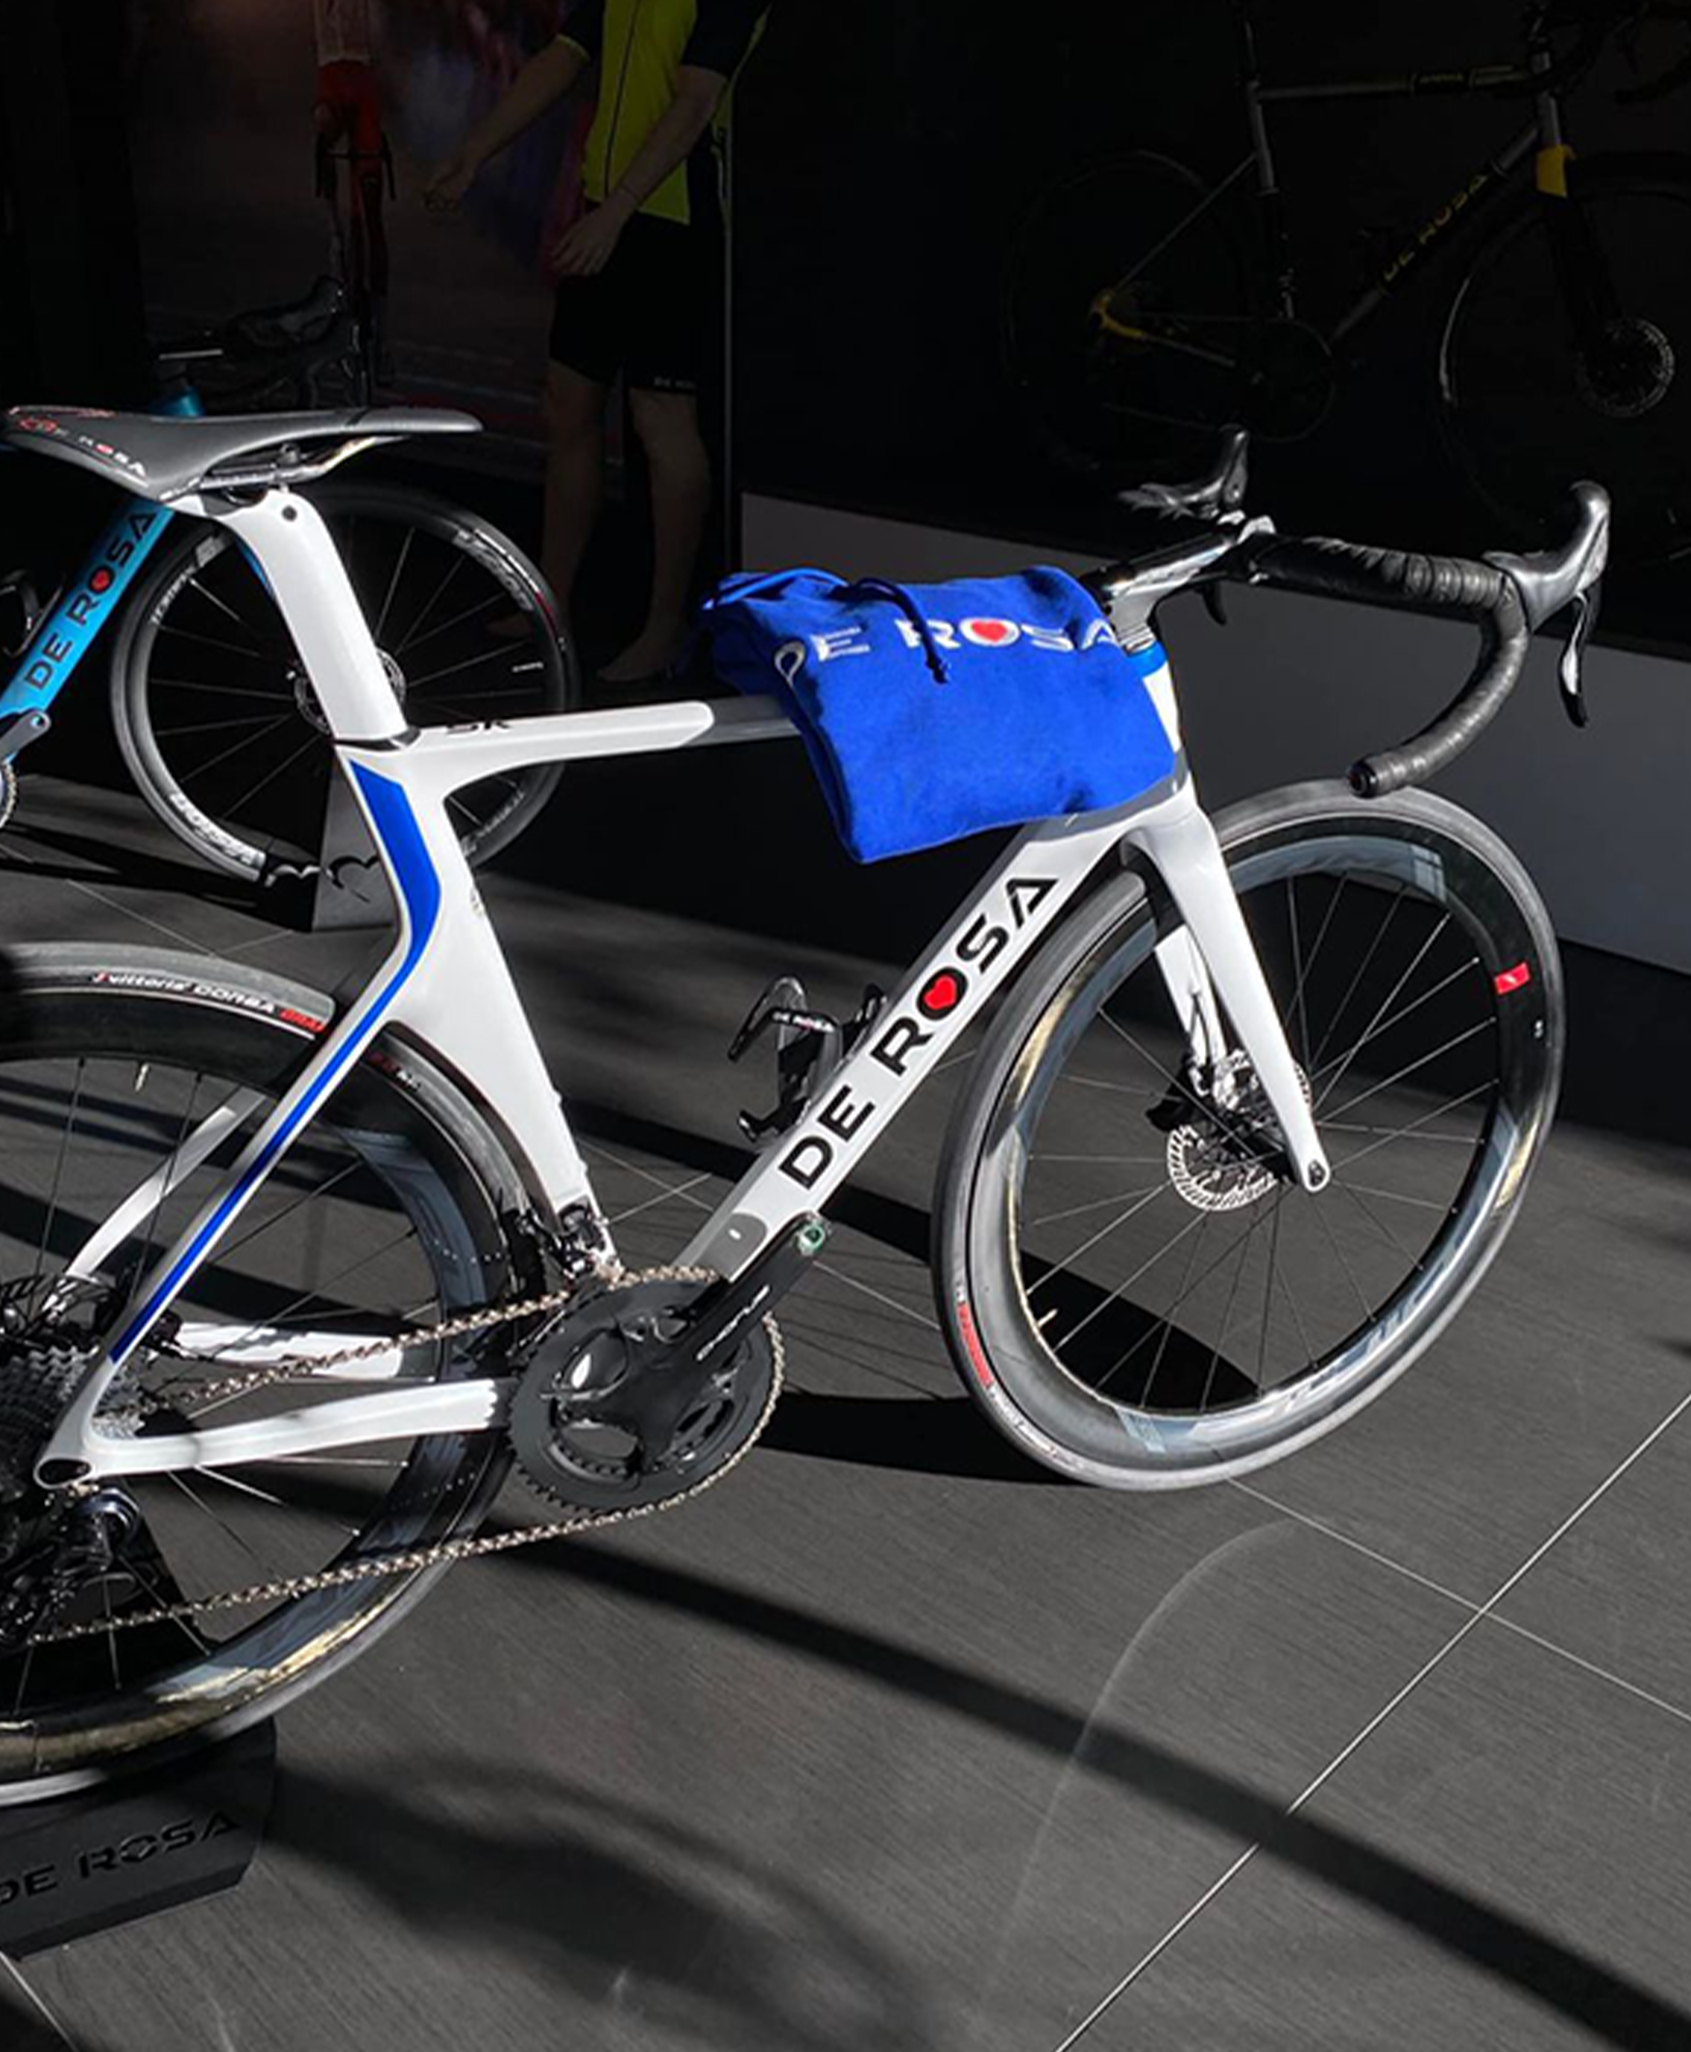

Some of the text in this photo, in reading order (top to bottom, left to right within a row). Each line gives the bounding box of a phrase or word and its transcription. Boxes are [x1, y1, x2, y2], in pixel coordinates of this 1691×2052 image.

[24, 508, 160, 690] DE ROSA
[894, 616, 1121, 652] ROSA
[109, 972, 189, 993] vittoria
[778, 1084, 876, 1190] DE
[869, 877, 1060, 1078] ROSA
[77, 1811, 241, 1879] ROSA
